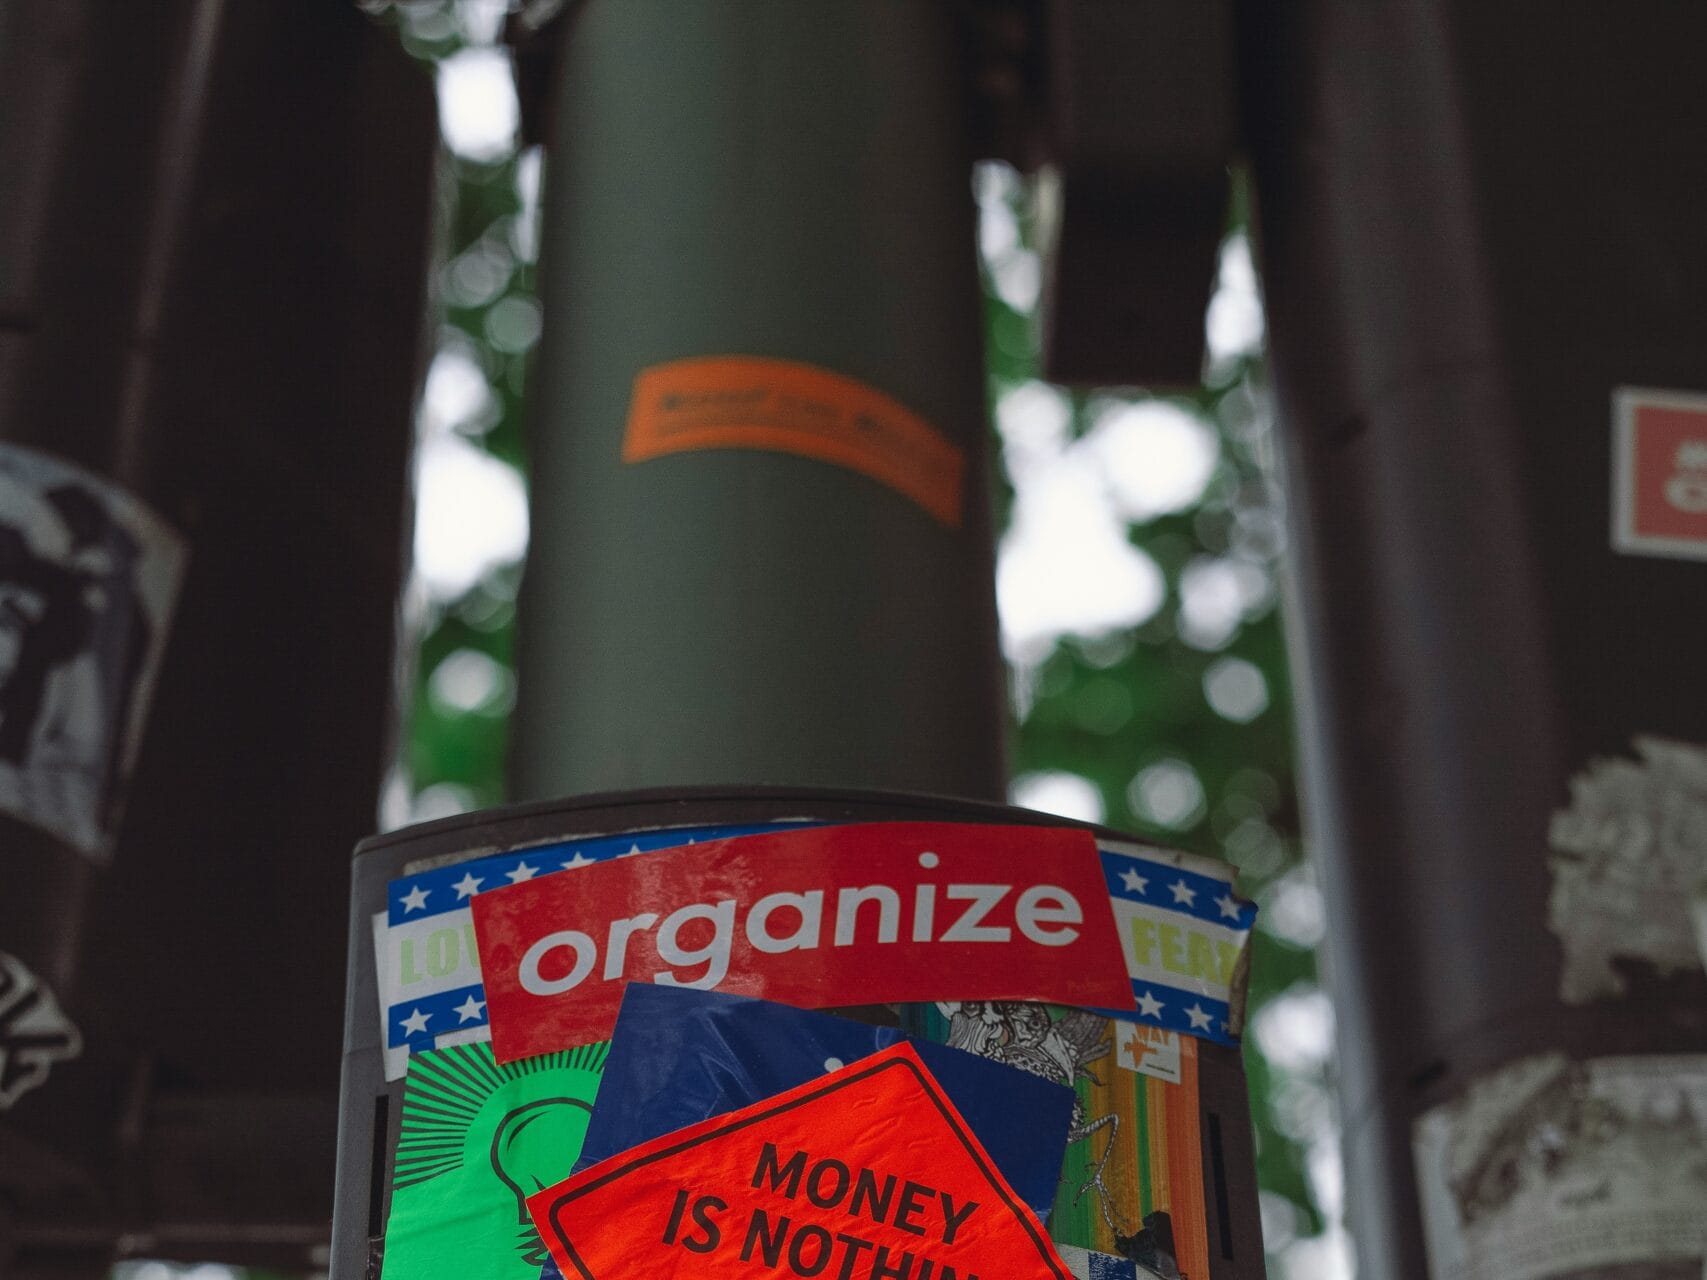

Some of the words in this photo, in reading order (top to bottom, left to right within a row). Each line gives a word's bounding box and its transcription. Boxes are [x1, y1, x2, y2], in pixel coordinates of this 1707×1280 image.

[518, 851, 1084, 991] organize
[661, 1188, 729, 1254] IS
[751, 1142, 981, 1246] MONEY
